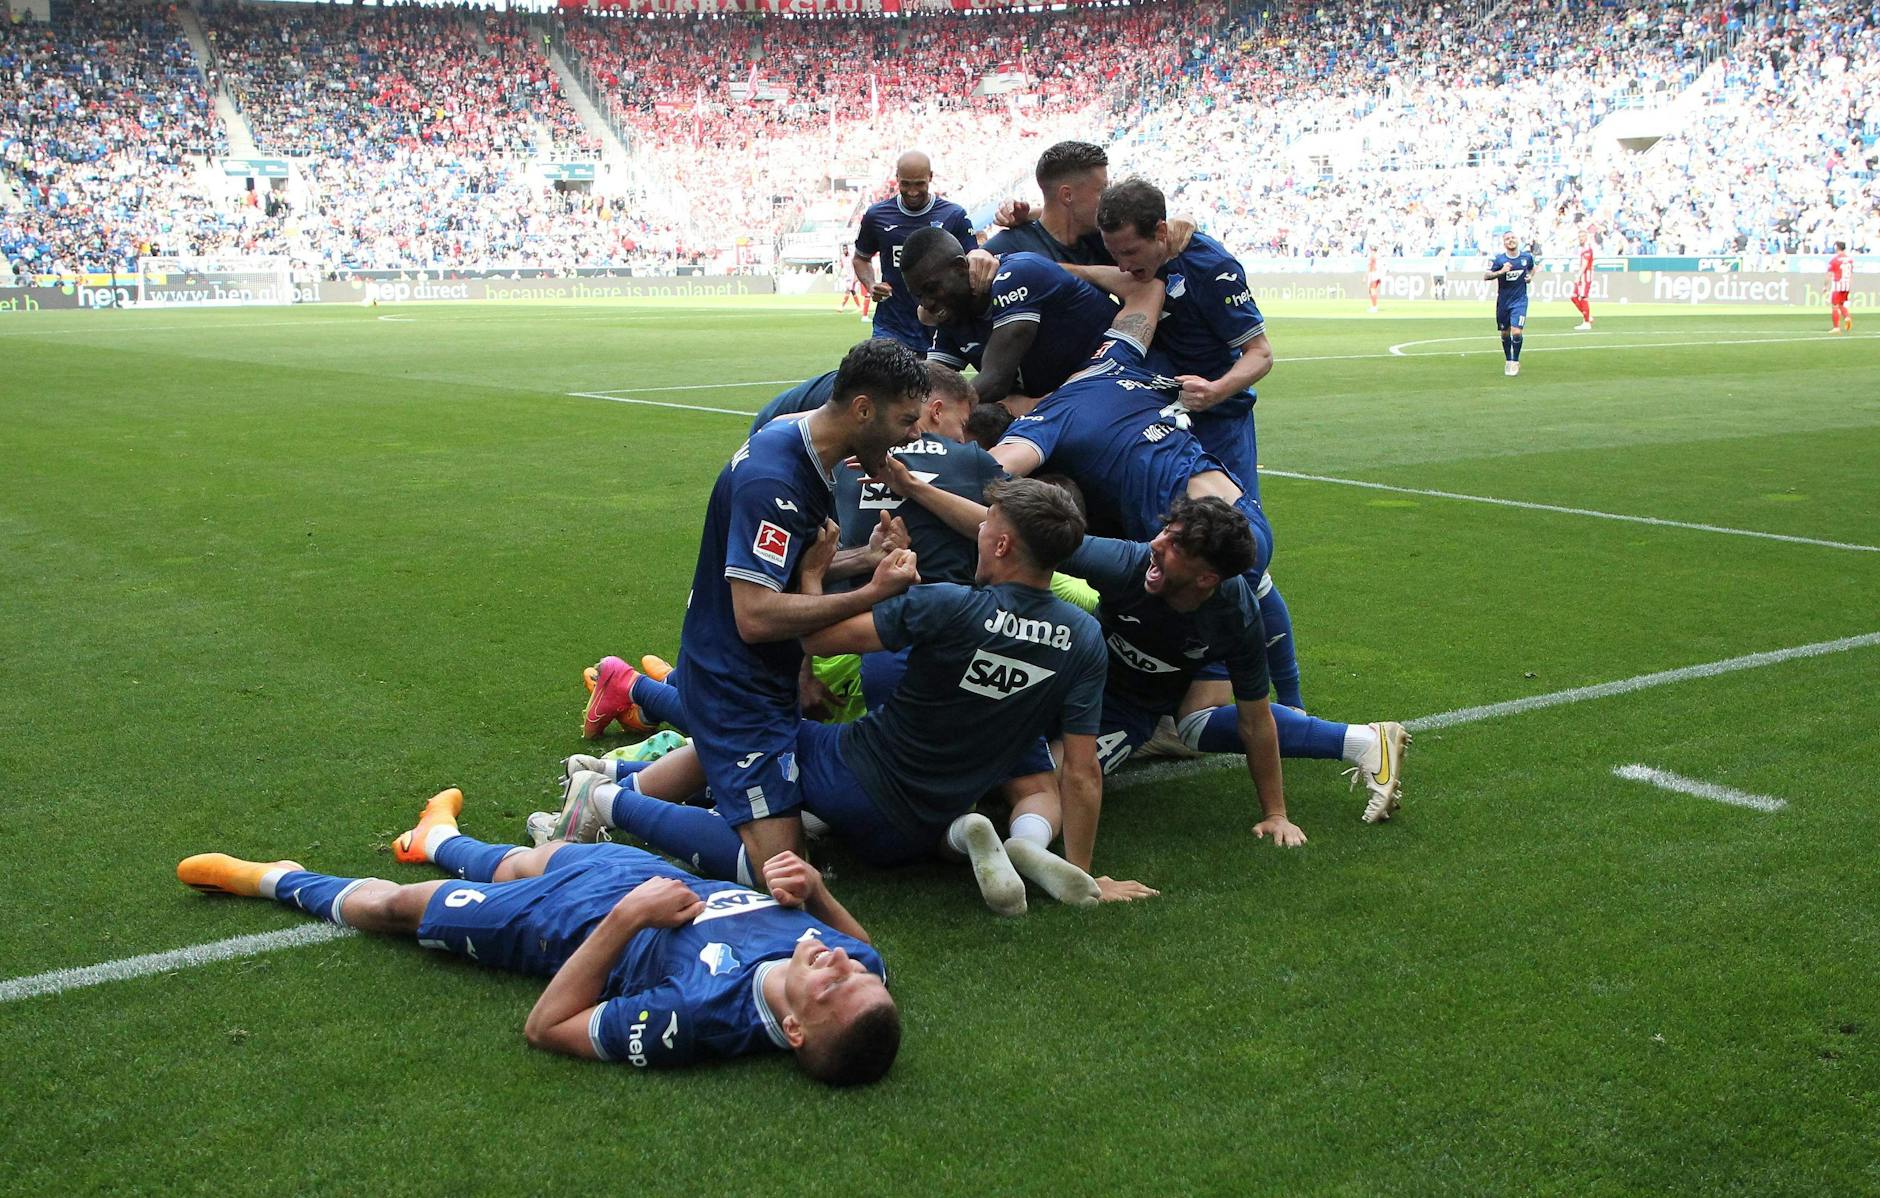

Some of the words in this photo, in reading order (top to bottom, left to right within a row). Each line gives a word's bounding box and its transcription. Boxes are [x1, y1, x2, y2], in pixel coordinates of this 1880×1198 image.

[413, 282, 469, 299] direct
[485, 284, 567, 300] because
[572, 283, 622, 299] there
[626, 282, 645, 297] is
[649, 284, 673, 297] no
[676, 281, 733, 297] planet
[998, 286, 1028, 308] hep
[1654, 271, 1711, 304] hep
[1714, 274, 1789, 301] direct
[862, 482, 906, 501] SA
[984, 608, 1072, 651] Joma
[1111, 636, 1158, 672] SAP
[965, 659, 1029, 694] SAP
[1096, 730, 1132, 776] 40
[444, 888, 487, 908] 6
[628, 1023, 648, 1067] hep
